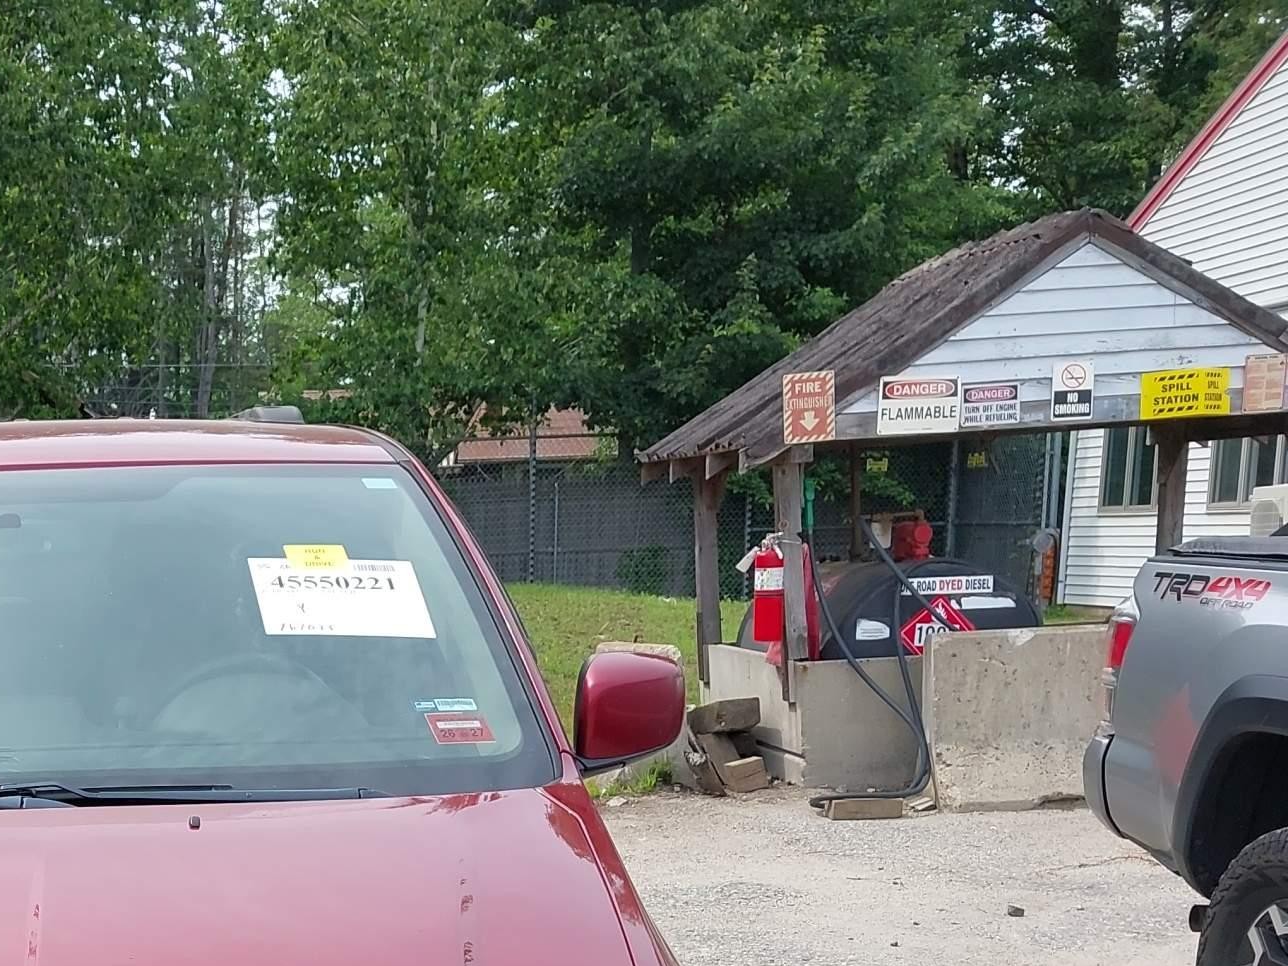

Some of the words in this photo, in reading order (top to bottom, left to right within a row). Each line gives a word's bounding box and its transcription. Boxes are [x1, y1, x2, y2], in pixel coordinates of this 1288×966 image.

[795, 381, 822, 394] FIRE
[893, 383, 948, 396] DANGER
[972, 389, 1011, 399] DANGER
[1161, 382, 1192, 393] SPILL
[1066, 392, 1079, 403] NO
[1153, 393, 1200, 406] STATION
[881, 405, 957, 421] FLAMMABLE
[964, 405, 980, 414] TURN
[983, 404, 993, 413] OFF
[996, 403, 1017, 412] ENGINE
[1054, 403, 1090, 415] SMOKING
[962, 415, 983, 424] WHILE
[985, 412, 1018, 422] REFUELING
[270, 575, 396, 590] 45550221
[917, 580, 937, 592] ROAD
[939, 579, 963, 591] DYED
[965, 578, 991, 590] DIESEL
[1154, 572, 1210, 601] TRD
